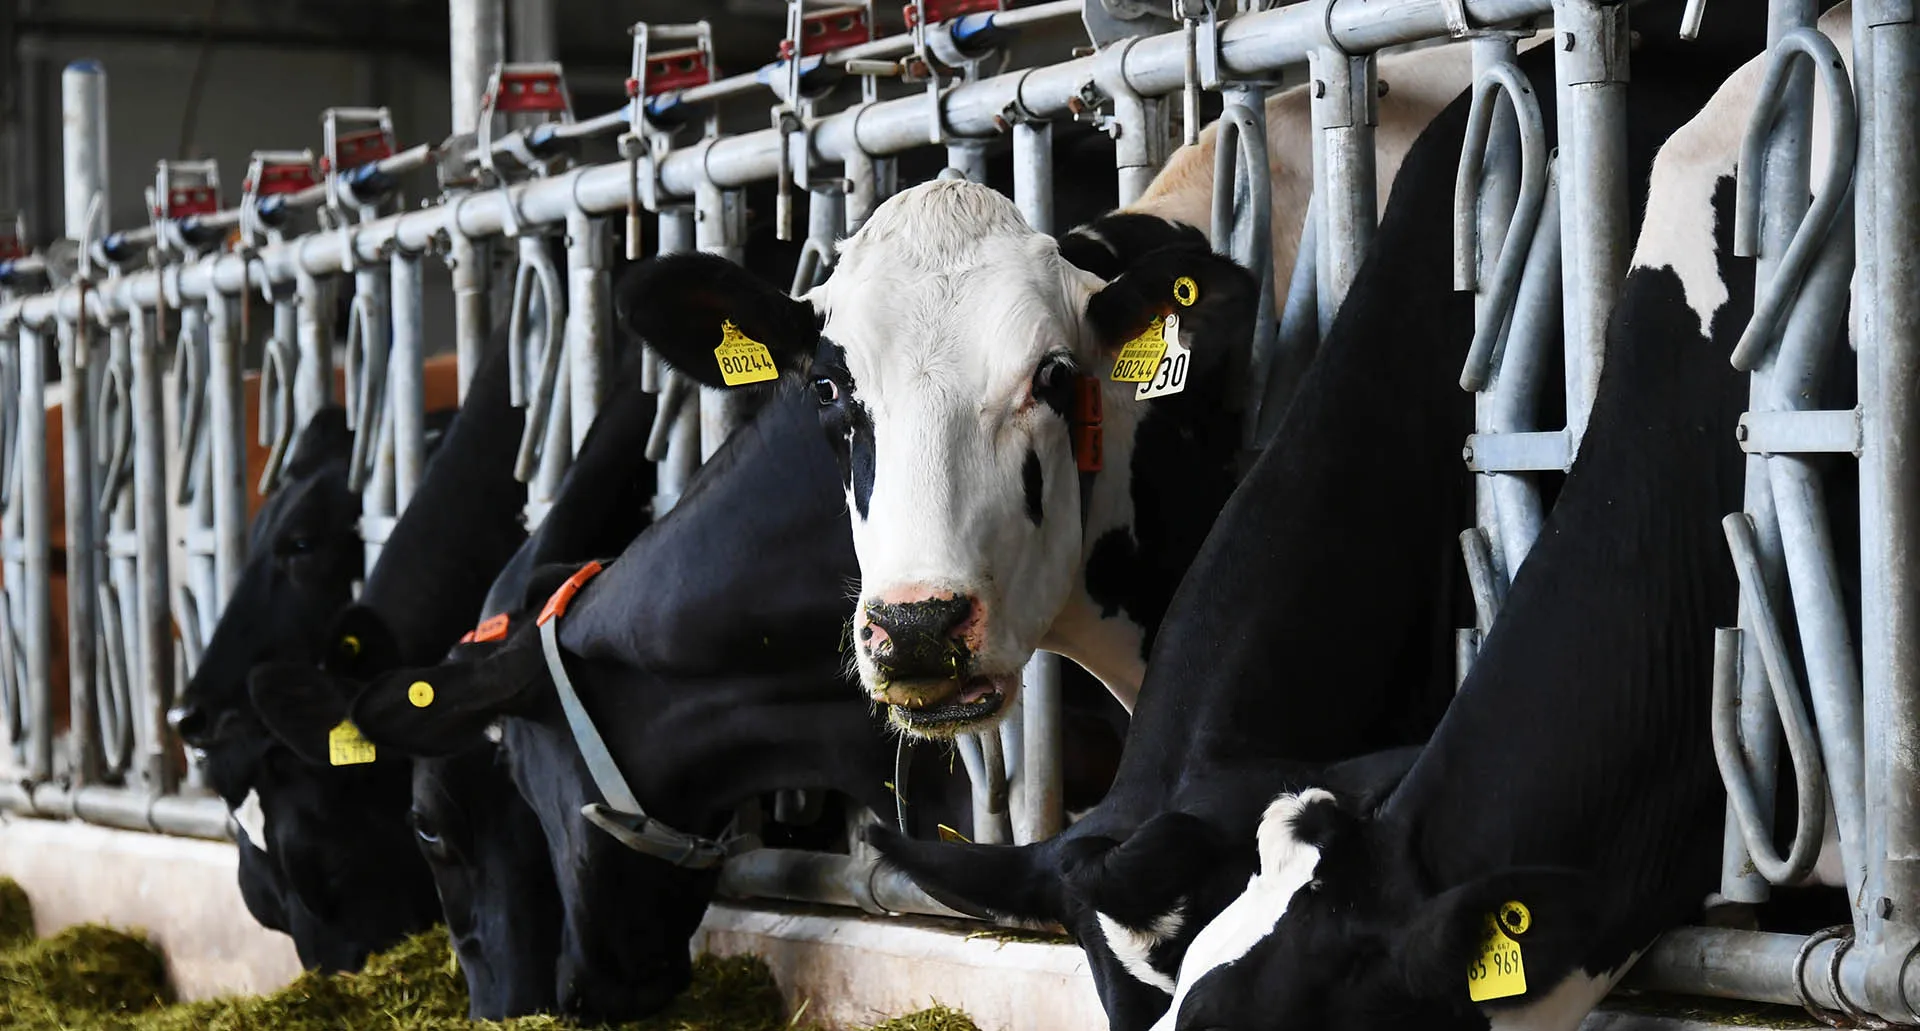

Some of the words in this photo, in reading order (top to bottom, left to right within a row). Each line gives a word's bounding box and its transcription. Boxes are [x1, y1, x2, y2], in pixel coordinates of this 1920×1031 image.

[722, 353, 772, 375] 80244
[1113, 359, 1154, 379] 80244
[1470, 960, 1486, 980] 65
[1494, 950, 1518, 976] 969
